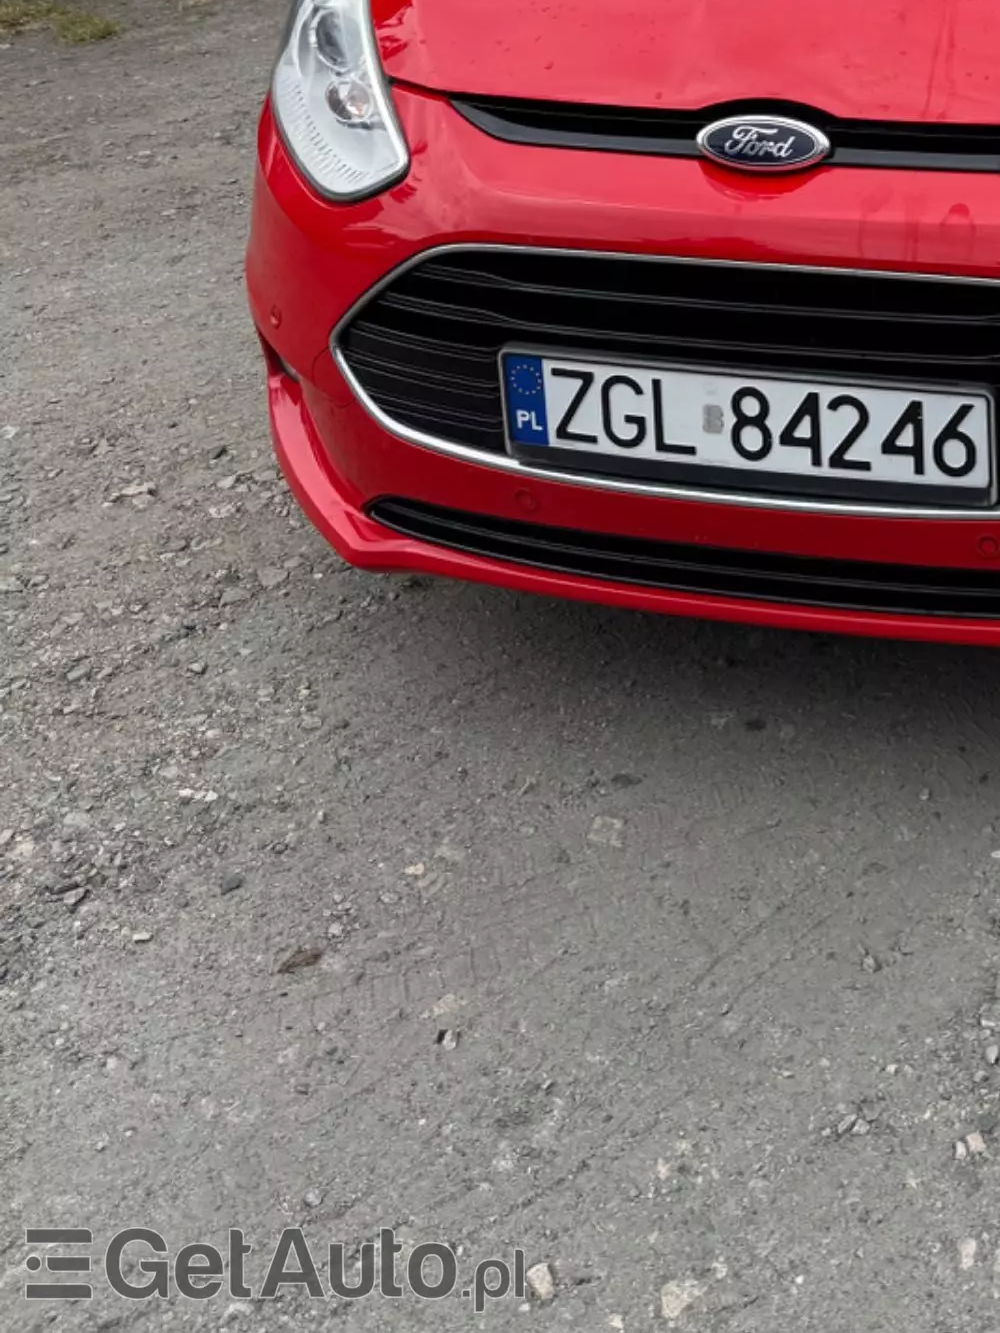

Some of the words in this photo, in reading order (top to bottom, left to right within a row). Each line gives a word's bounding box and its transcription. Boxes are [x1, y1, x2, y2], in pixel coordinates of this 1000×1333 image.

[724, 125, 795, 157] Ford
[516, 409, 543, 431] PL
[551, 368, 697, 456] ZGL
[730, 386, 977, 477] 84246
